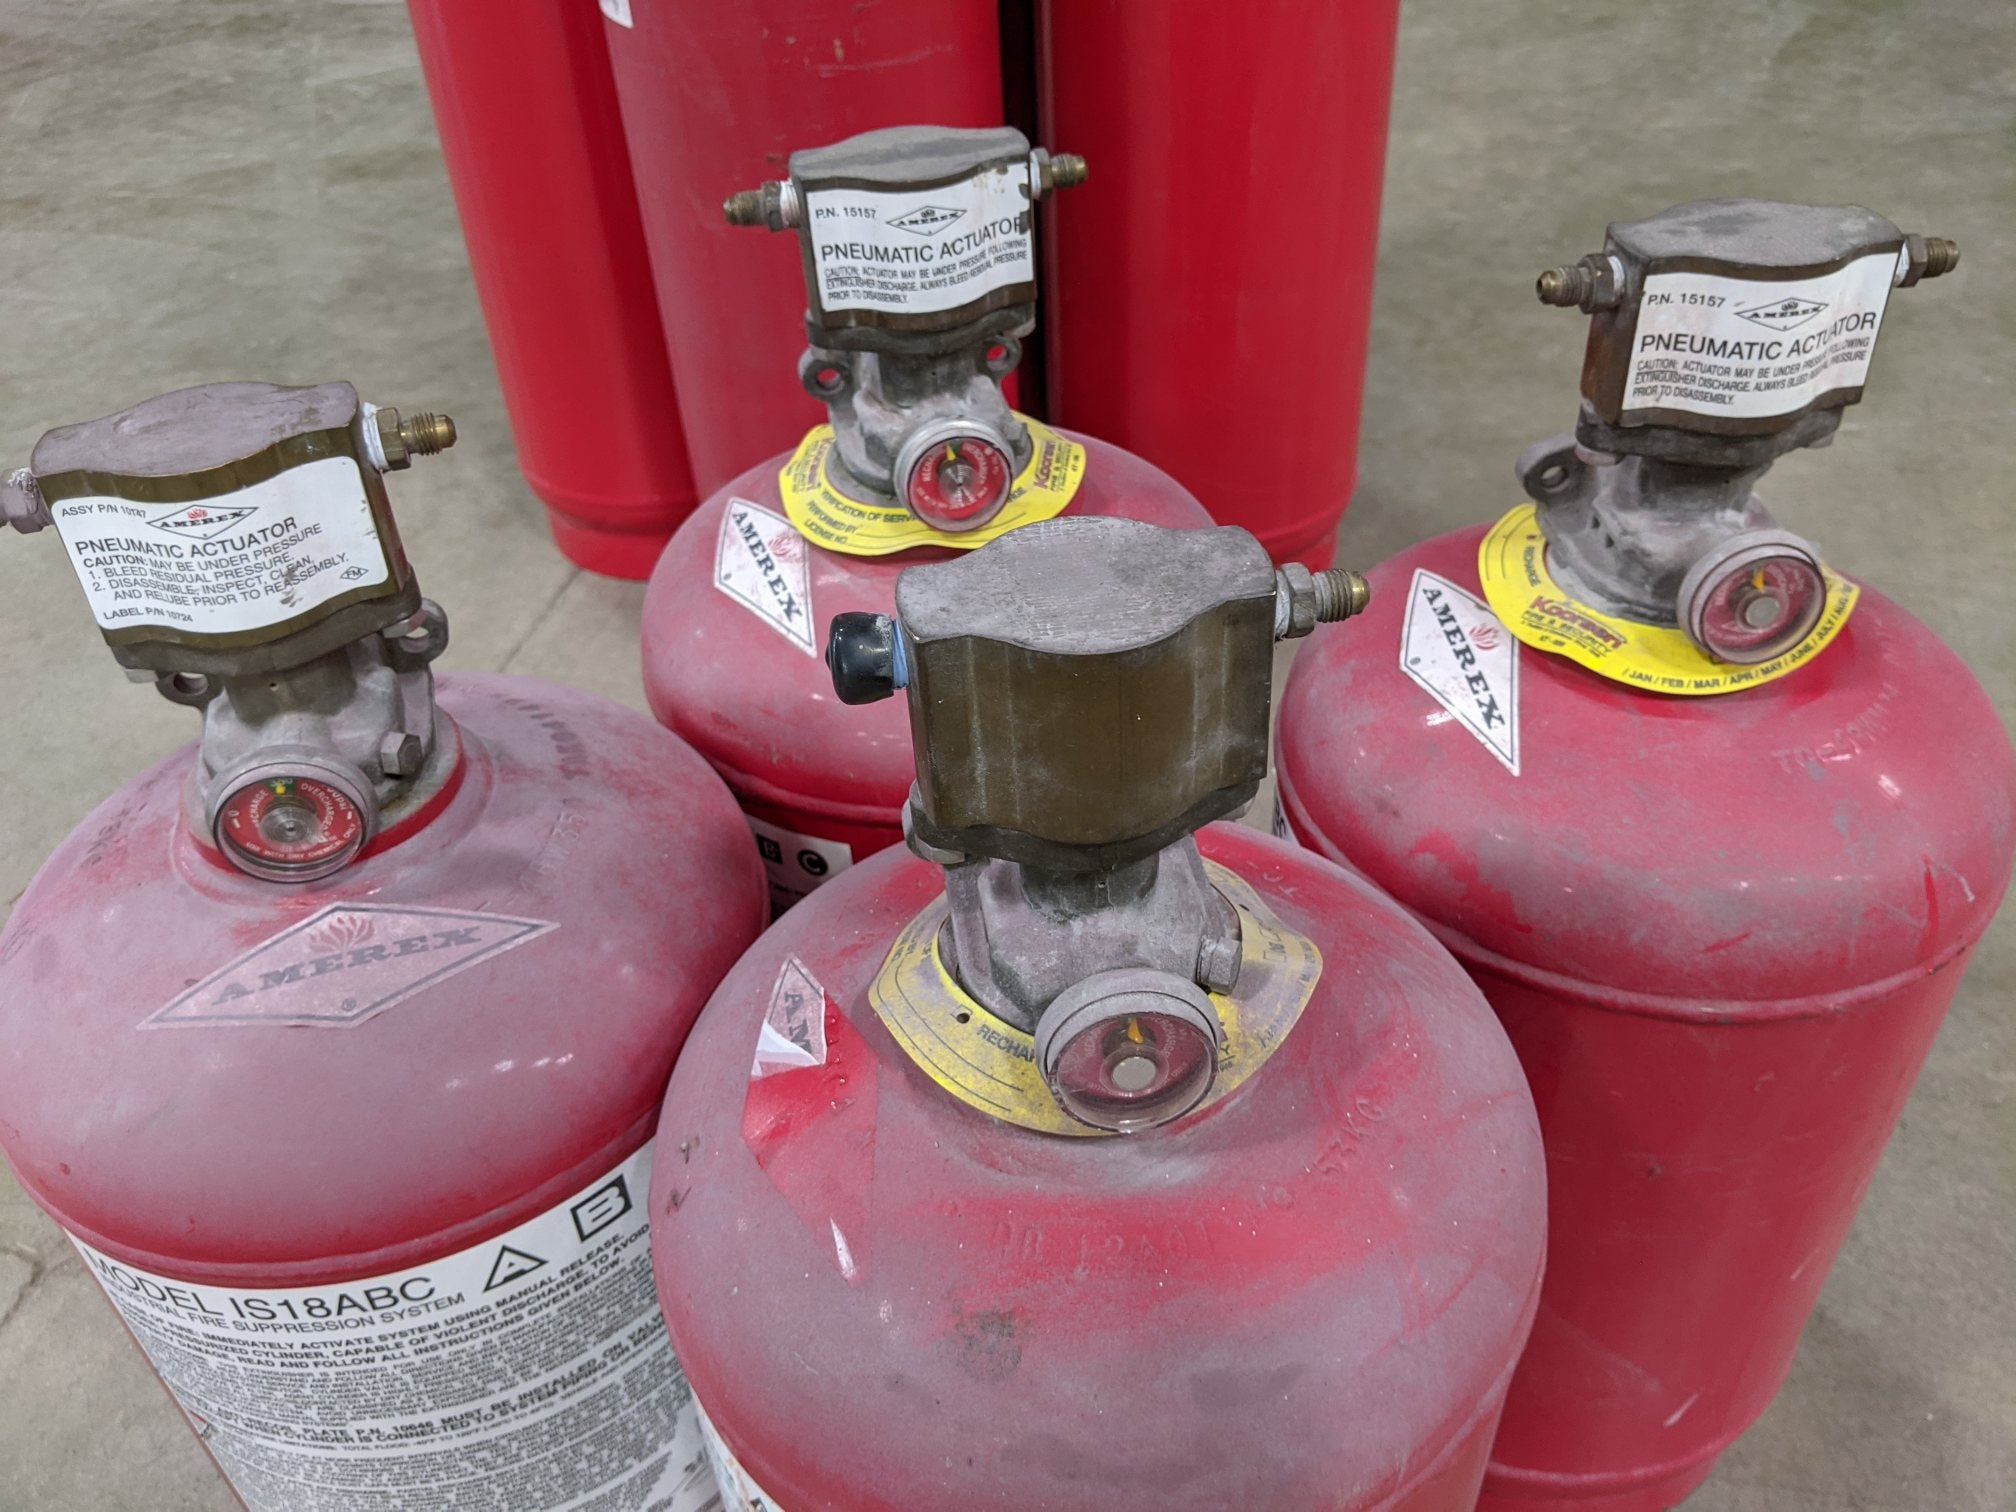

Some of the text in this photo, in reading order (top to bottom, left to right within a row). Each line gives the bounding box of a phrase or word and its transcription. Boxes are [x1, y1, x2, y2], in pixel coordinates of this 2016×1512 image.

[816, 207, 876, 219] P.N. 15157
[897, 212, 959, 226] AMEREX
[821, 243, 934, 263] PNEUMATIC
[862, 269, 898, 279] ACTUATOR
[901, 269, 916, 279] MAY
[920, 269, 930, 278] BE
[932, 263, 957, 277] UNDER
[920, 278, 948, 290] ALWAYS
[949, 272, 968, 286] BLEED
[994, 250, 1028, 266] PRESSURE
[828, 290, 849, 301] PRIOR
[851, 290, 860, 300] TO
[1647, 293, 1727, 307] P.N. 15157
[1748, 305, 1821, 319] AMEREX
[1640, 312, 1876, 360] PNEUMATIC ACTUATOR
[1634, 371, 1697, 386] EXTINGUISHER
[1753, 375, 1786, 392] ALWAYS
[1830, 350, 1867, 368] PRESSURE
[1682, 362, 1732, 377] ACTUATOR
[1735, 367, 1754, 378] MAY
[1757, 368, 1769, 378] BE
[1772, 363, 1800, 377] UNDER
[1632, 385, 1657, 397] PRIOR
[1660, 385, 1672, 396] TO
[61, 505, 93, 518] ASSY
[98, 504, 119, 515] P/N
[159, 509, 245, 529] AMEREX
[867, 512, 881, 521] OF
[76, 517, 298, 559] PNEUMATIC ACTUATOR
[84, 523, 322, 572] CAUTION: MAY BE UNDER PRESSURE
[89, 571, 101, 580] 1.
[104, 567, 148, 580] BLEED
[149, 569, 211, 583] RESIDUAL
[732, 510, 803, 623] AMEREX
[93, 582, 106, 592] 2.
[114, 588, 142, 601] AND
[145, 591, 191, 606] RELUBE
[193, 593, 239, 607] PRIOR
[242, 588, 261, 602] TO
[104, 608, 143, 621] LABEL
[145, 607, 165, 618] P/N
[1422, 586, 1505, 730] AMEREX
[1629, 671, 1653, 683] JAN
[1661, 677, 1684, 688] FEB
[1693, 679, 1720, 689] MAR
[1729, 672, 1754, 684] APR
[1760, 662, 1783, 676] MAY
[210, 925, 483, 1006] AMEREX
[977, 1024, 1035, 1062] RECHA
[83, 1247, 223, 1316] MODEL
[228, 1276, 436, 1321] IS18ABC
[162, 1326, 250, 1356] PRESSURIZED
[332, 1342, 404, 1358] CAPABLE
[409, 1336, 429, 1346] OF
[433, 1313, 498, 1340] VIOLENT
[591, 1254, 609, 1269] TO
[613, 1223, 650, 1256] AVOID
[188, 1312, 229, 1329] FIRE
[232, 1315, 376, 1334] SUPPRESSION
[382, 1292, 466, 1325] SYSTEM
[202, 1331, 295, 1350] IMMEDIATELY
[300, 1336, 375, 1350] ACTIVATE
[379, 1321, 440, 1343] SYSTEM
[444, 1304, 493, 1327] USING
[496, 1275, 558, 1309] MANUAL
[236, 1354, 276, 1368] READ
[280, 1358, 309, 1369] AND
[313, 1356, 376, 1369] FOLLOW
[381, 1350, 411, 1363] ALL
[413, 1313, 526, 1356] INSTRUCTIONS
[527, 1286, 570, 1316] GIVEN
[335, 1366, 388, 1377] INTENDED
[393, 1360, 416, 1370] FOR
[421, 1354, 443, 1364] USE
[302, 1427, 348, 1437] PLATE
[440, 1408, 482, 1424] MUST
[490, 1398, 511, 1412] BE
[517, 1358, 597, 1401] INSTALLED
[283, 1430, 355, 1444] CYLINDER
[358, 1435, 373, 1444] IS
[375, 1419, 472, 1443] CONNECTED
[475, 1412, 496, 1424] TO
[499, 1389, 558, 1417] SYSTEM
